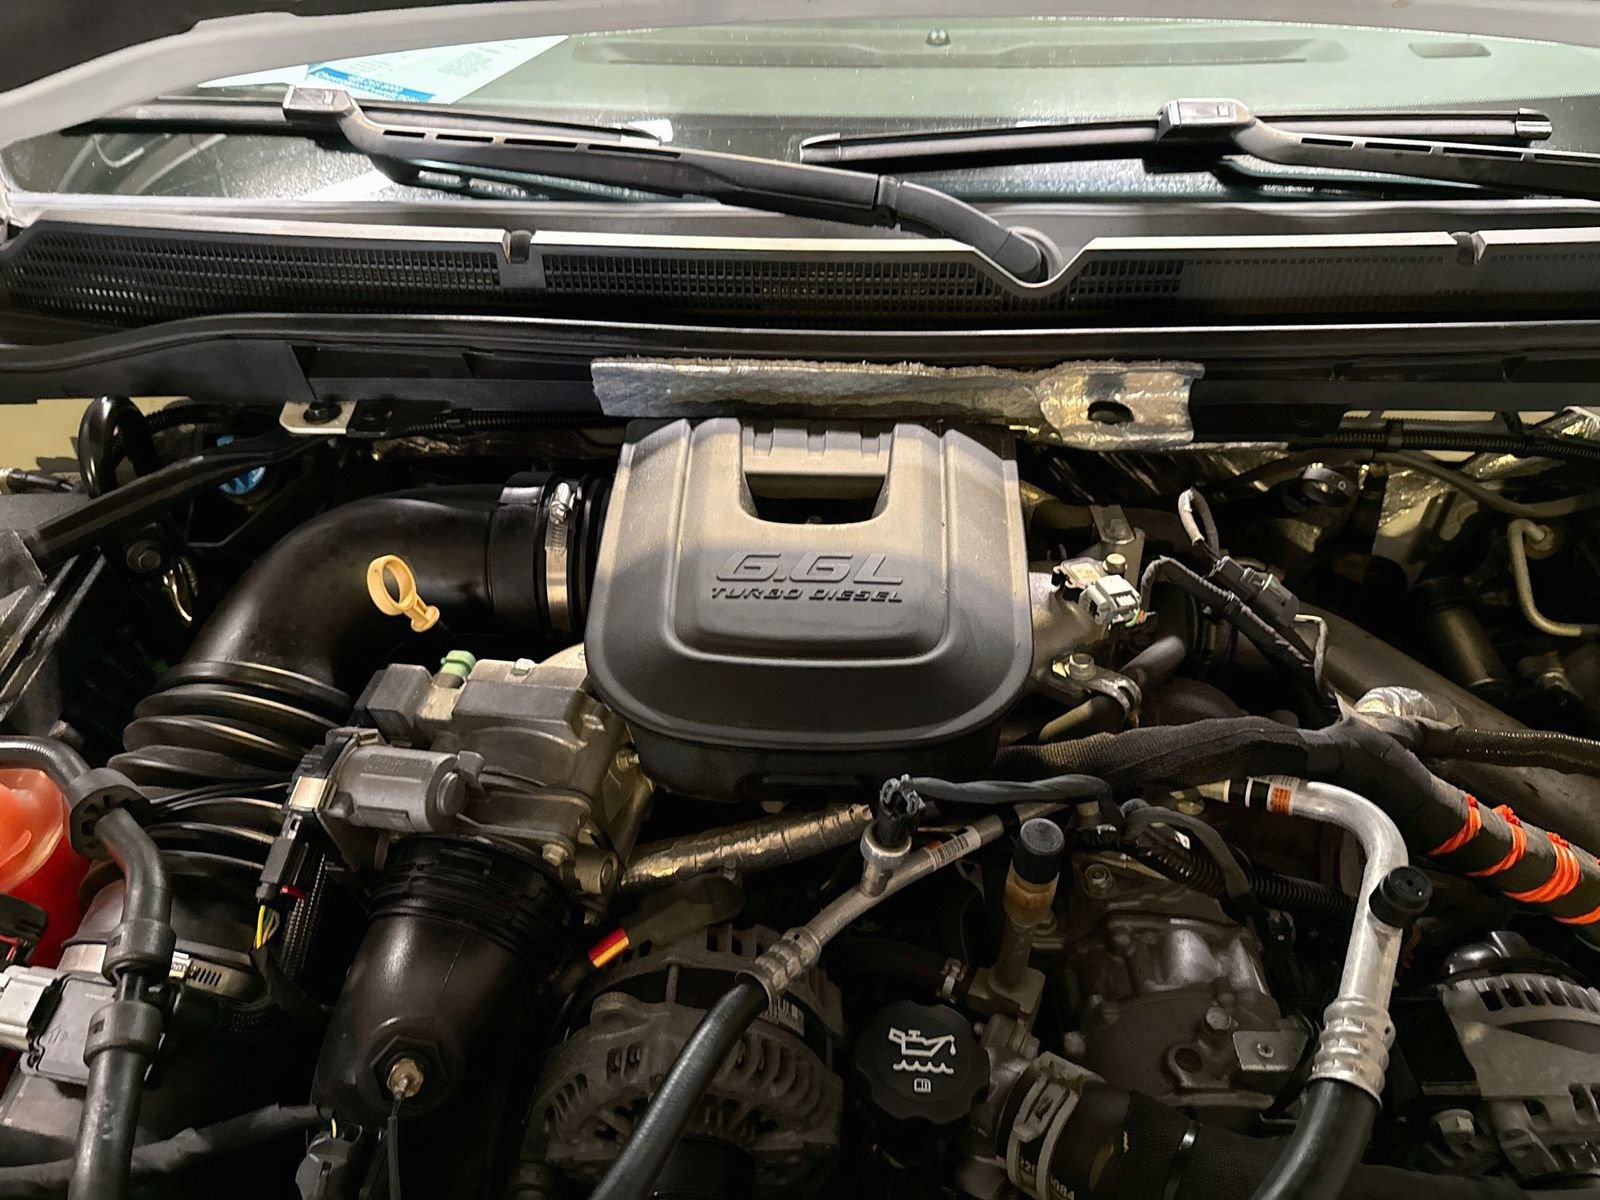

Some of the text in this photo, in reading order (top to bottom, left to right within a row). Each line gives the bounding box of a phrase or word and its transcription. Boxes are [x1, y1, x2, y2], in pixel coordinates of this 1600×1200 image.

[716, 551, 903, 585] 6.6L
[711, 587, 902, 603] TURBO DIESEL
